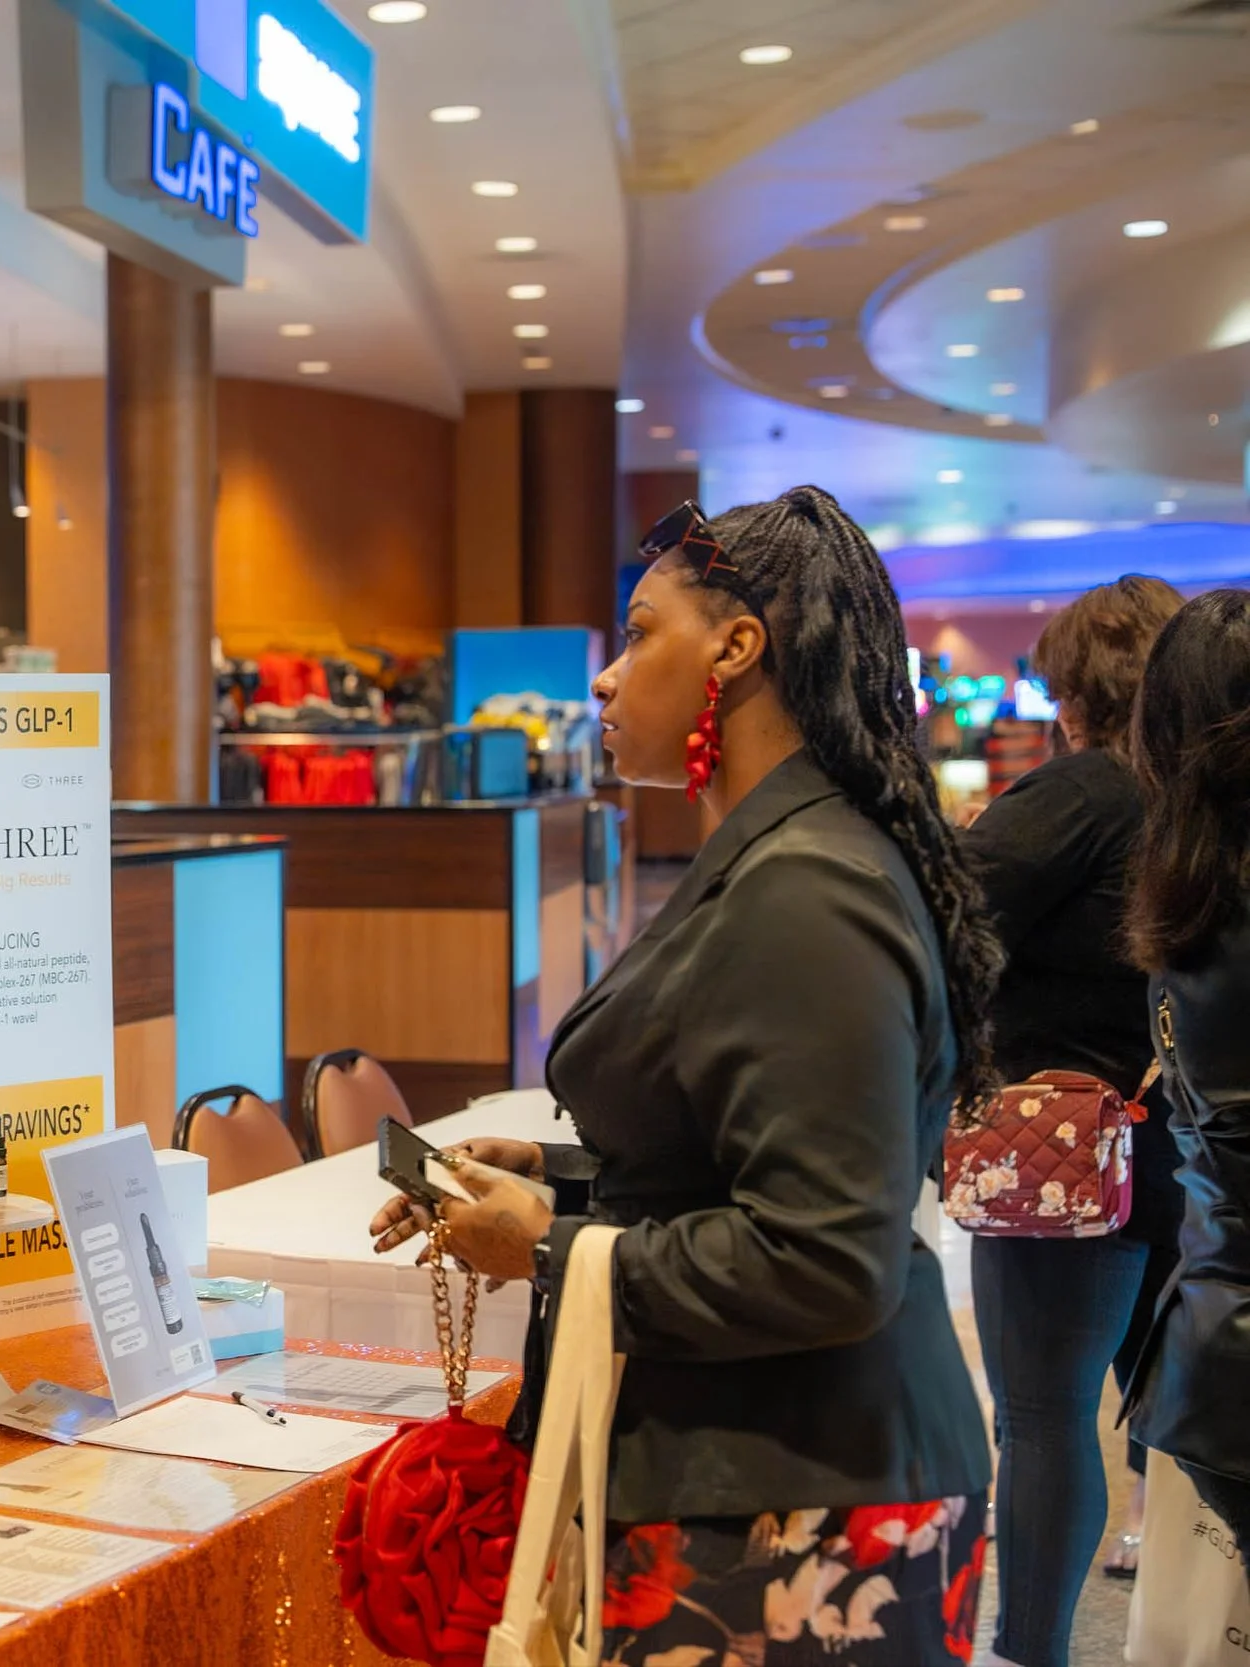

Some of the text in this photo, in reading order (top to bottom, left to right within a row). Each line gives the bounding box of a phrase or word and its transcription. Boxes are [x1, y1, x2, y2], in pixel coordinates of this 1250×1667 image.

[15, 706, 74, 733] GLP-1
[49, 775, 85, 786] THREE
[3, 953, 49, 970] all-natural
[21, 991, 57, 1006] solution
[22, 1220, 68, 1255] MAS
[1192, 1519, 1246, 1566] #GLO
